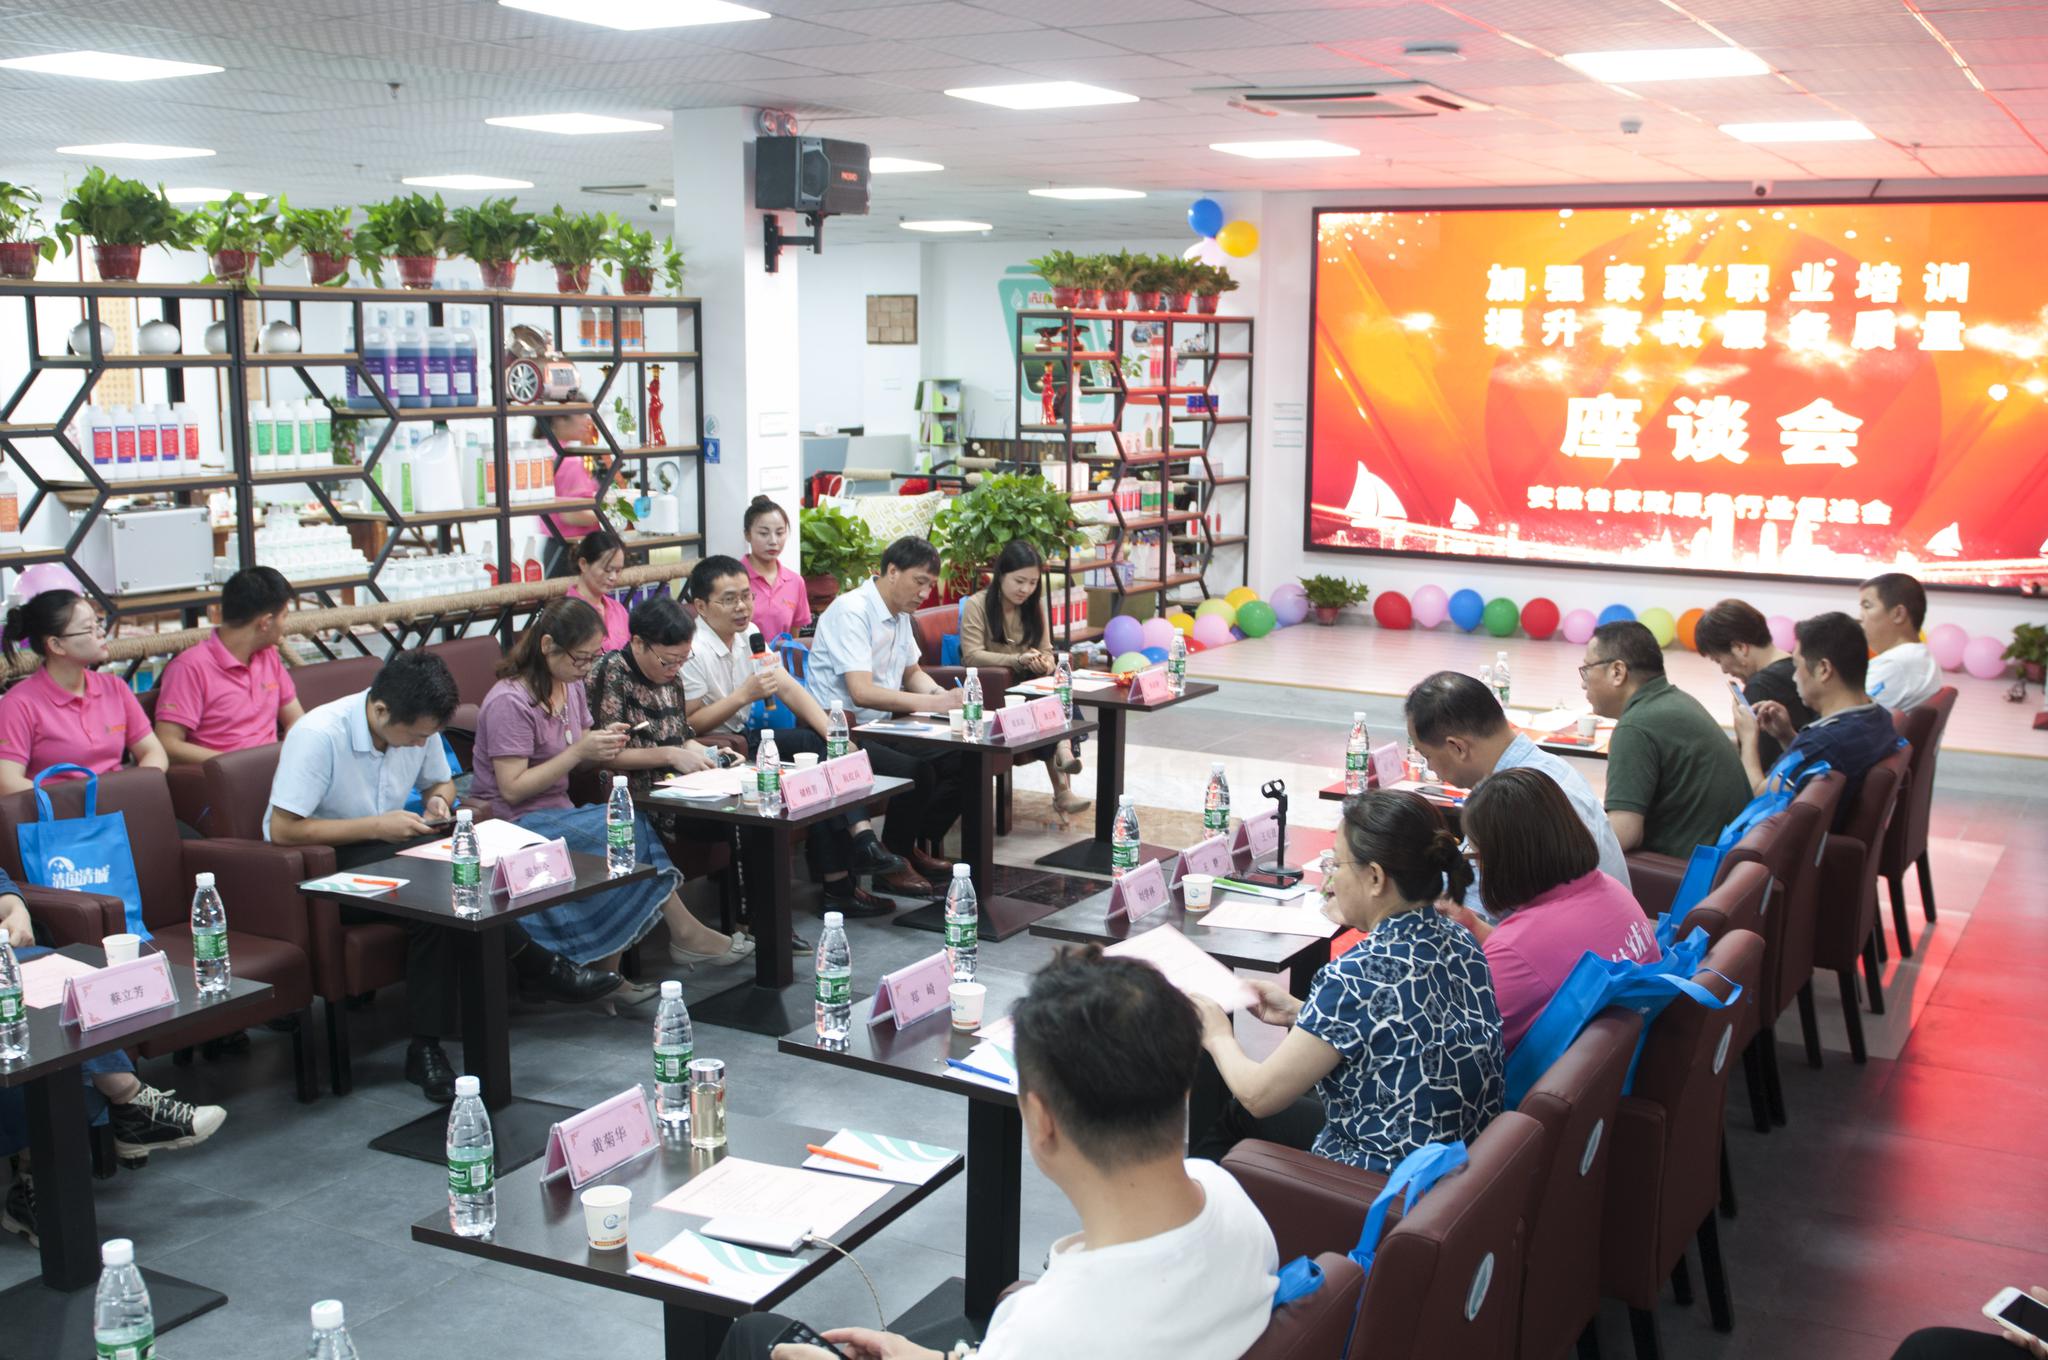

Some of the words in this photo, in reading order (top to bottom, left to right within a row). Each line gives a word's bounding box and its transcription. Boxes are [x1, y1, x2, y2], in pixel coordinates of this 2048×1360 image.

[1485, 263, 1969, 303] 加强家政职业培训
[1560, 392, 1863, 468] 座谈会
[591, 1126, 627, 1156] 黄菊华
